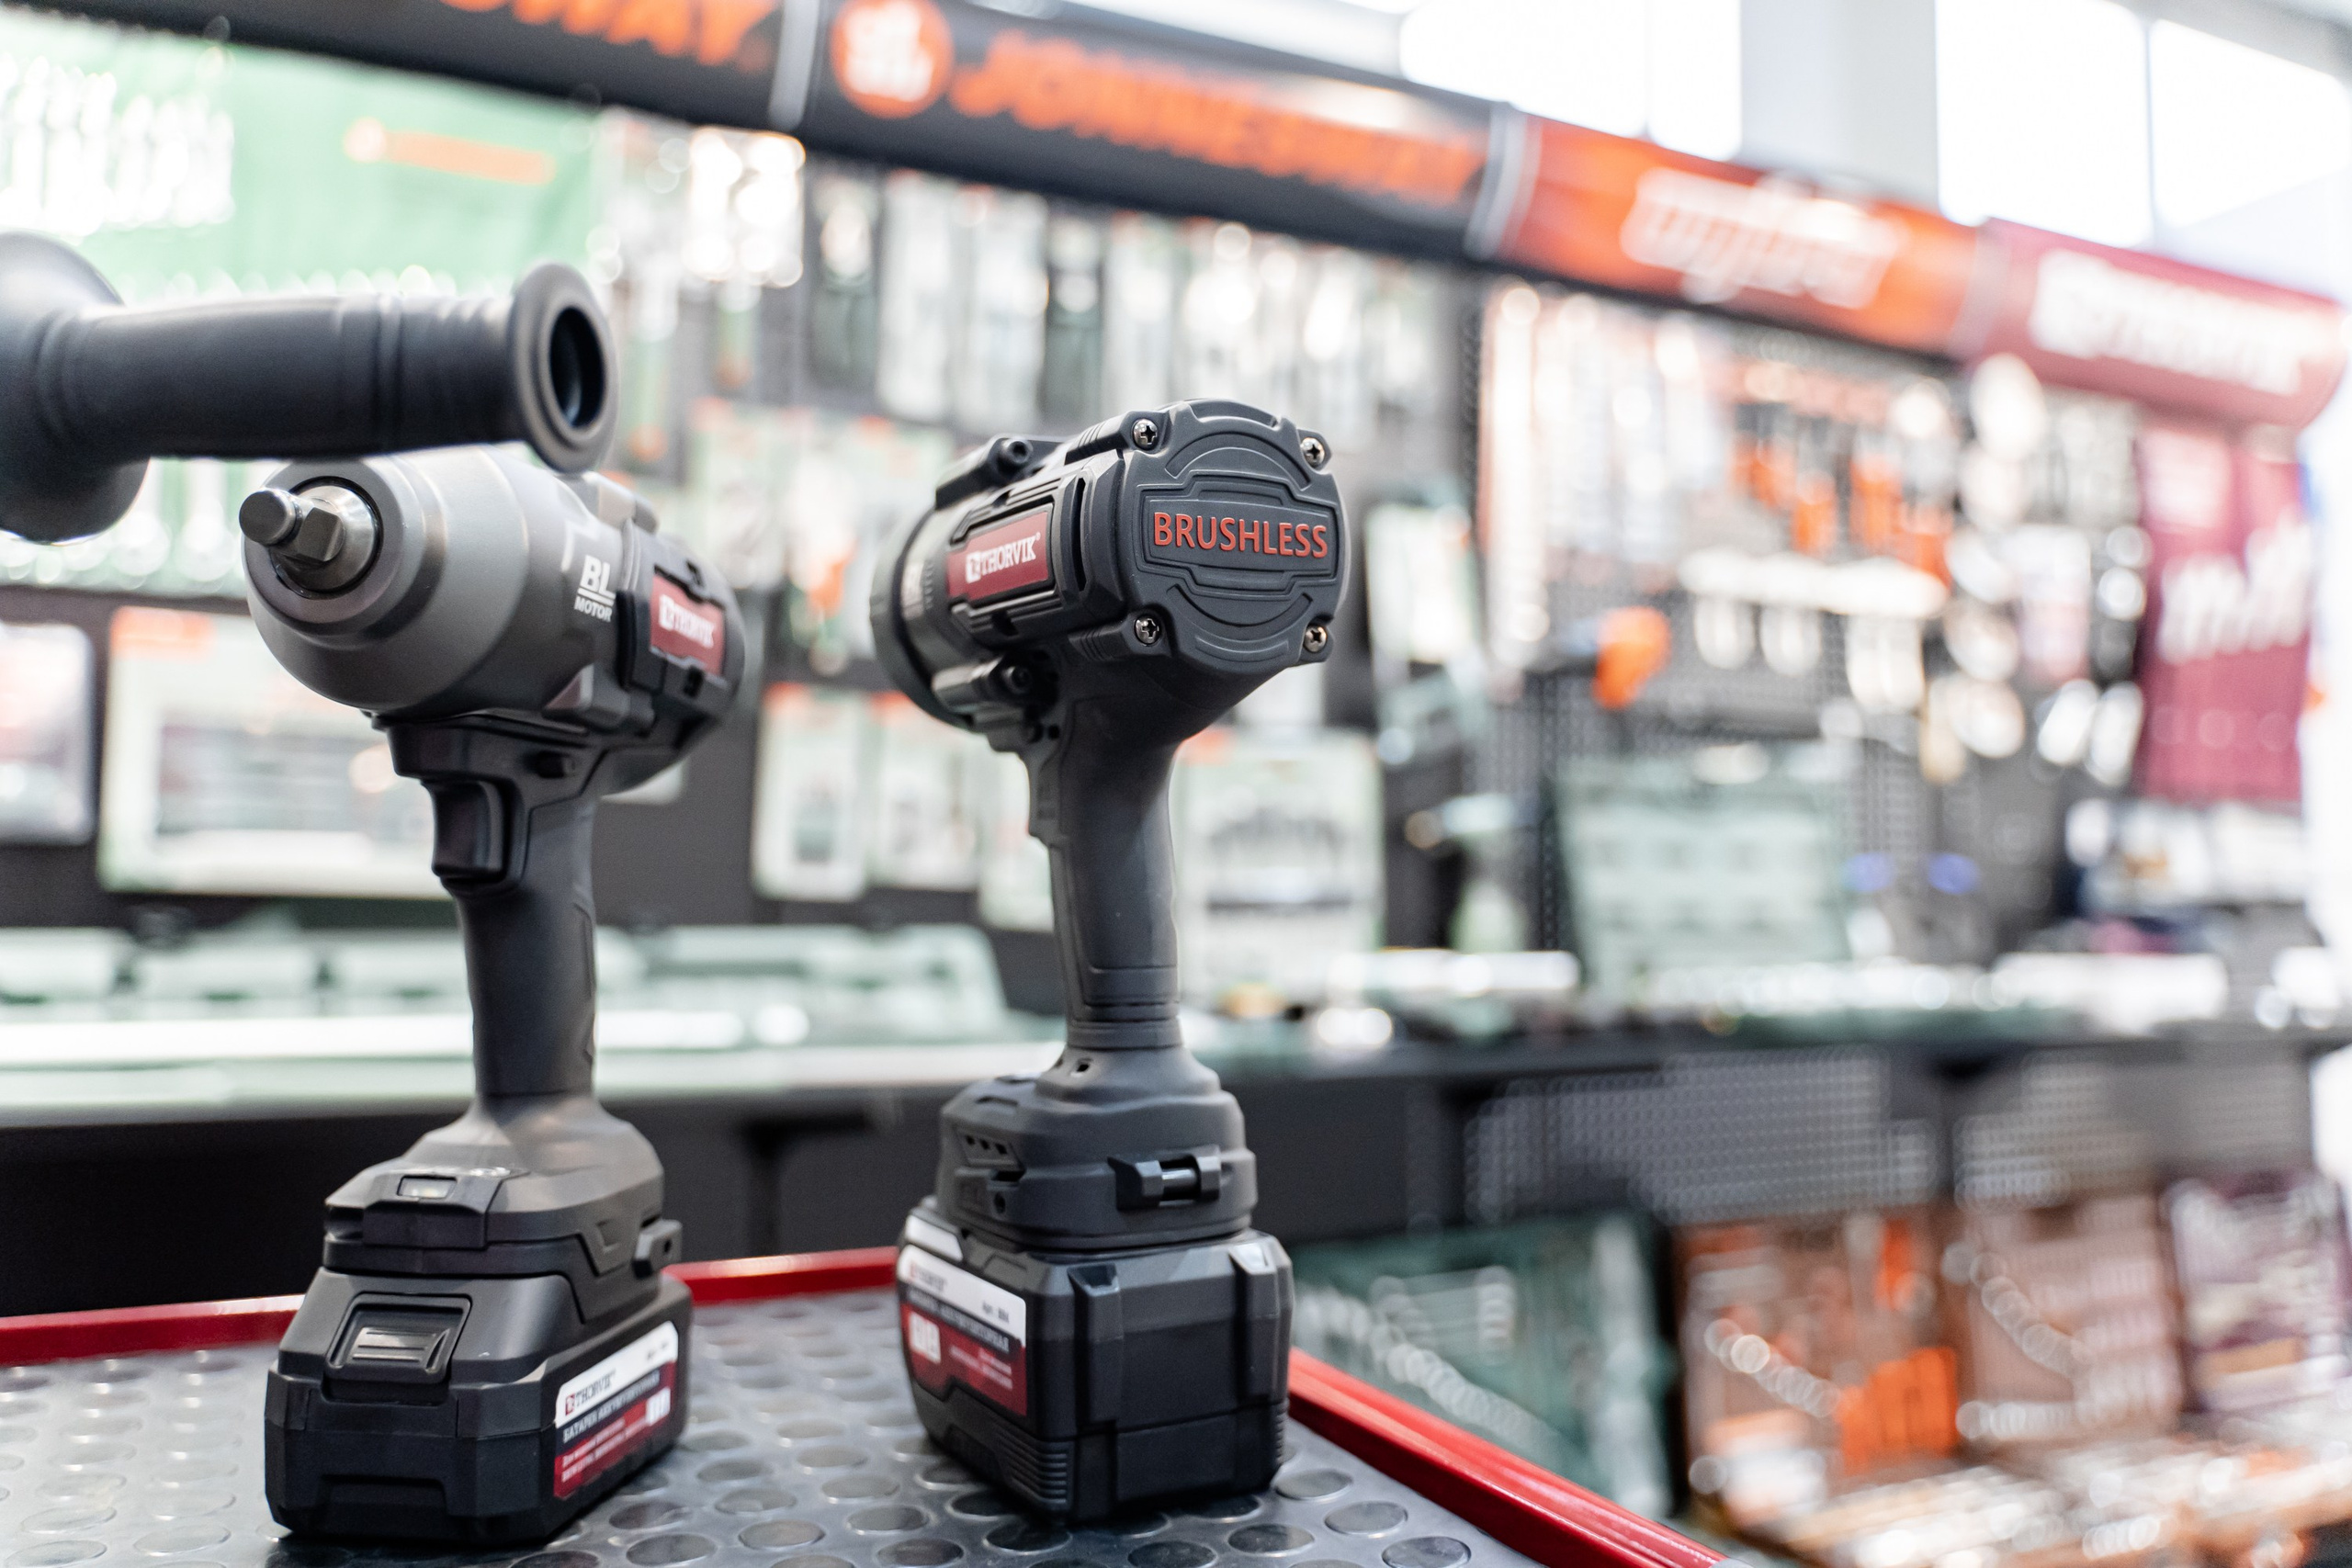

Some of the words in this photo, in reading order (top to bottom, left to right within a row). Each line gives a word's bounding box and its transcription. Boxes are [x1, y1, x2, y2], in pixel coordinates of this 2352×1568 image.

[979, 534, 1037, 576] THORVIK
[1154, 512, 1329, 558] BRUSHLESS
[580, 555, 616, 600] BL
[574, 597, 613, 622] MOTOR
